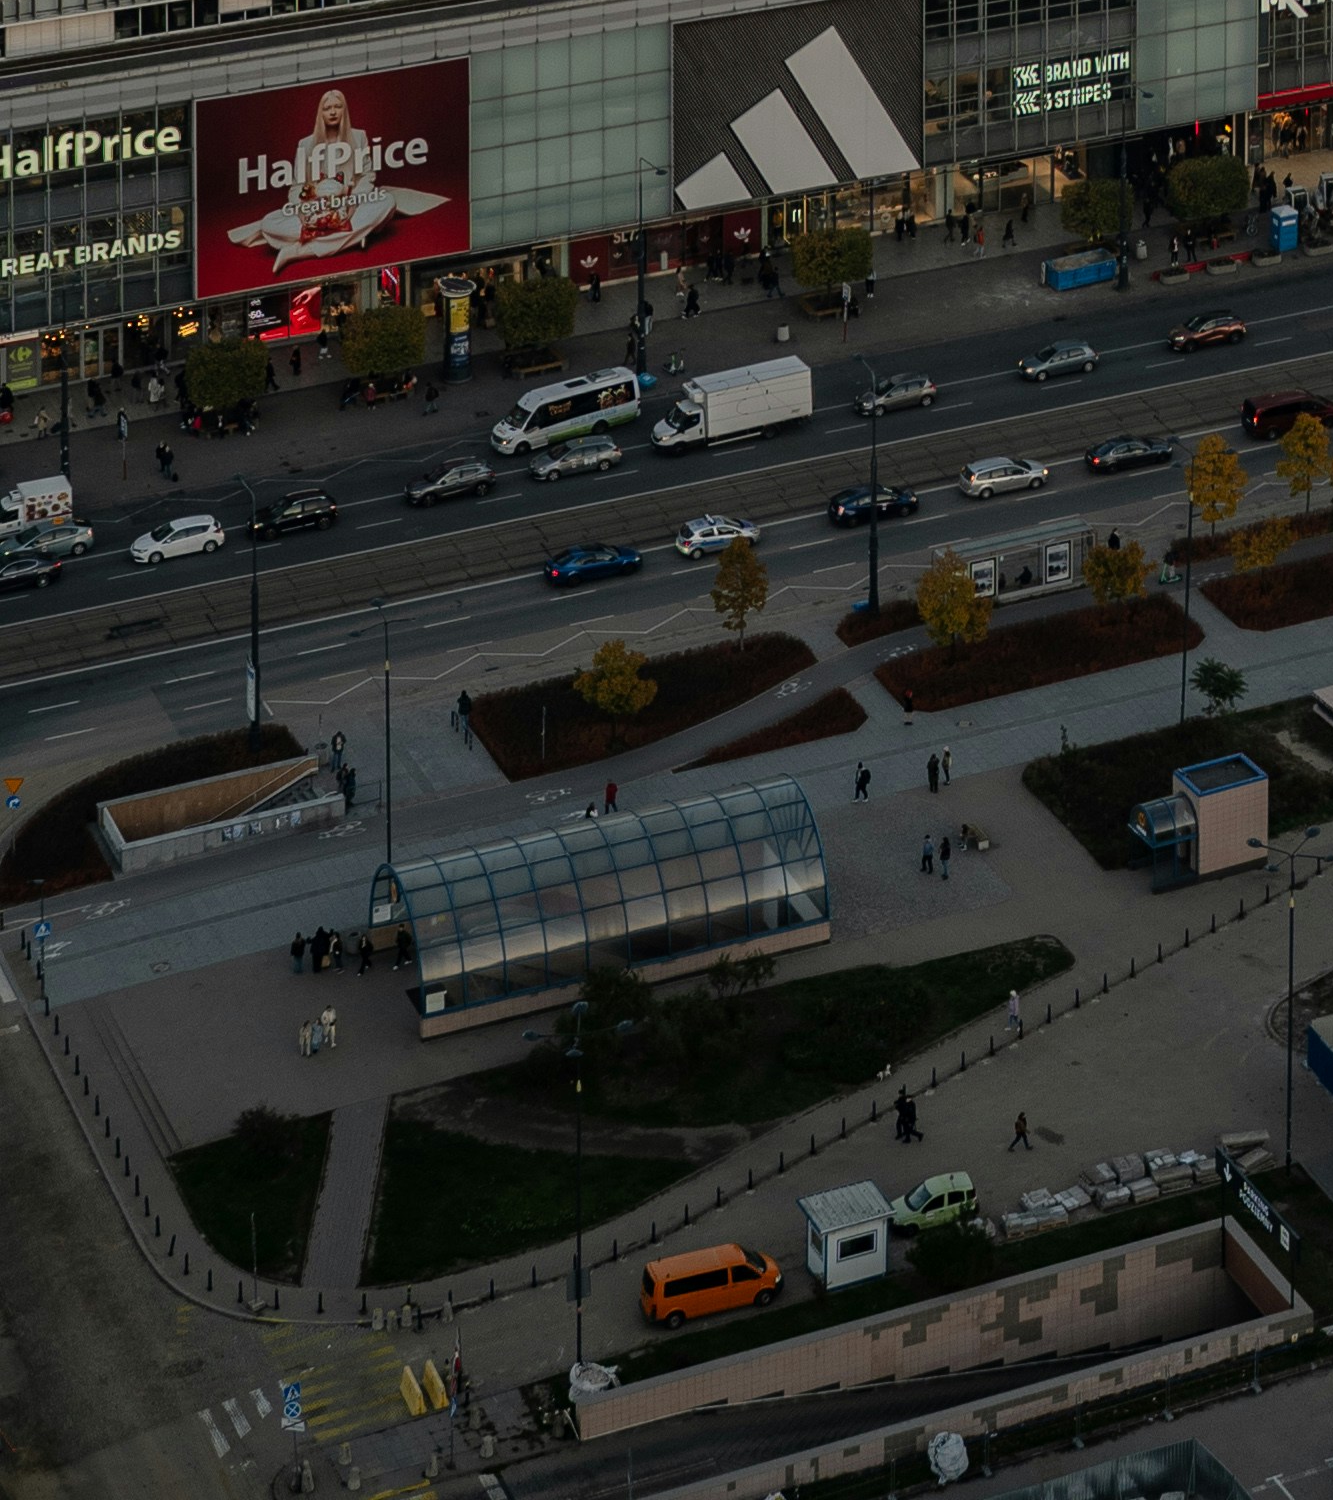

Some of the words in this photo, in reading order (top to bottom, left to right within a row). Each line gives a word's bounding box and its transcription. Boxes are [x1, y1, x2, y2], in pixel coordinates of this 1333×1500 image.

[1045, 57, 1091, 82] BRAND
[1094, 51, 1129, 74] WITH
[1054, 81, 1112, 109] STRIPES
[238, 136, 429, 195] HalfPrice
[282, 198, 328, 217] Great
[332, 187, 387, 207] brands
[74, 229, 182, 265] BRANDS
